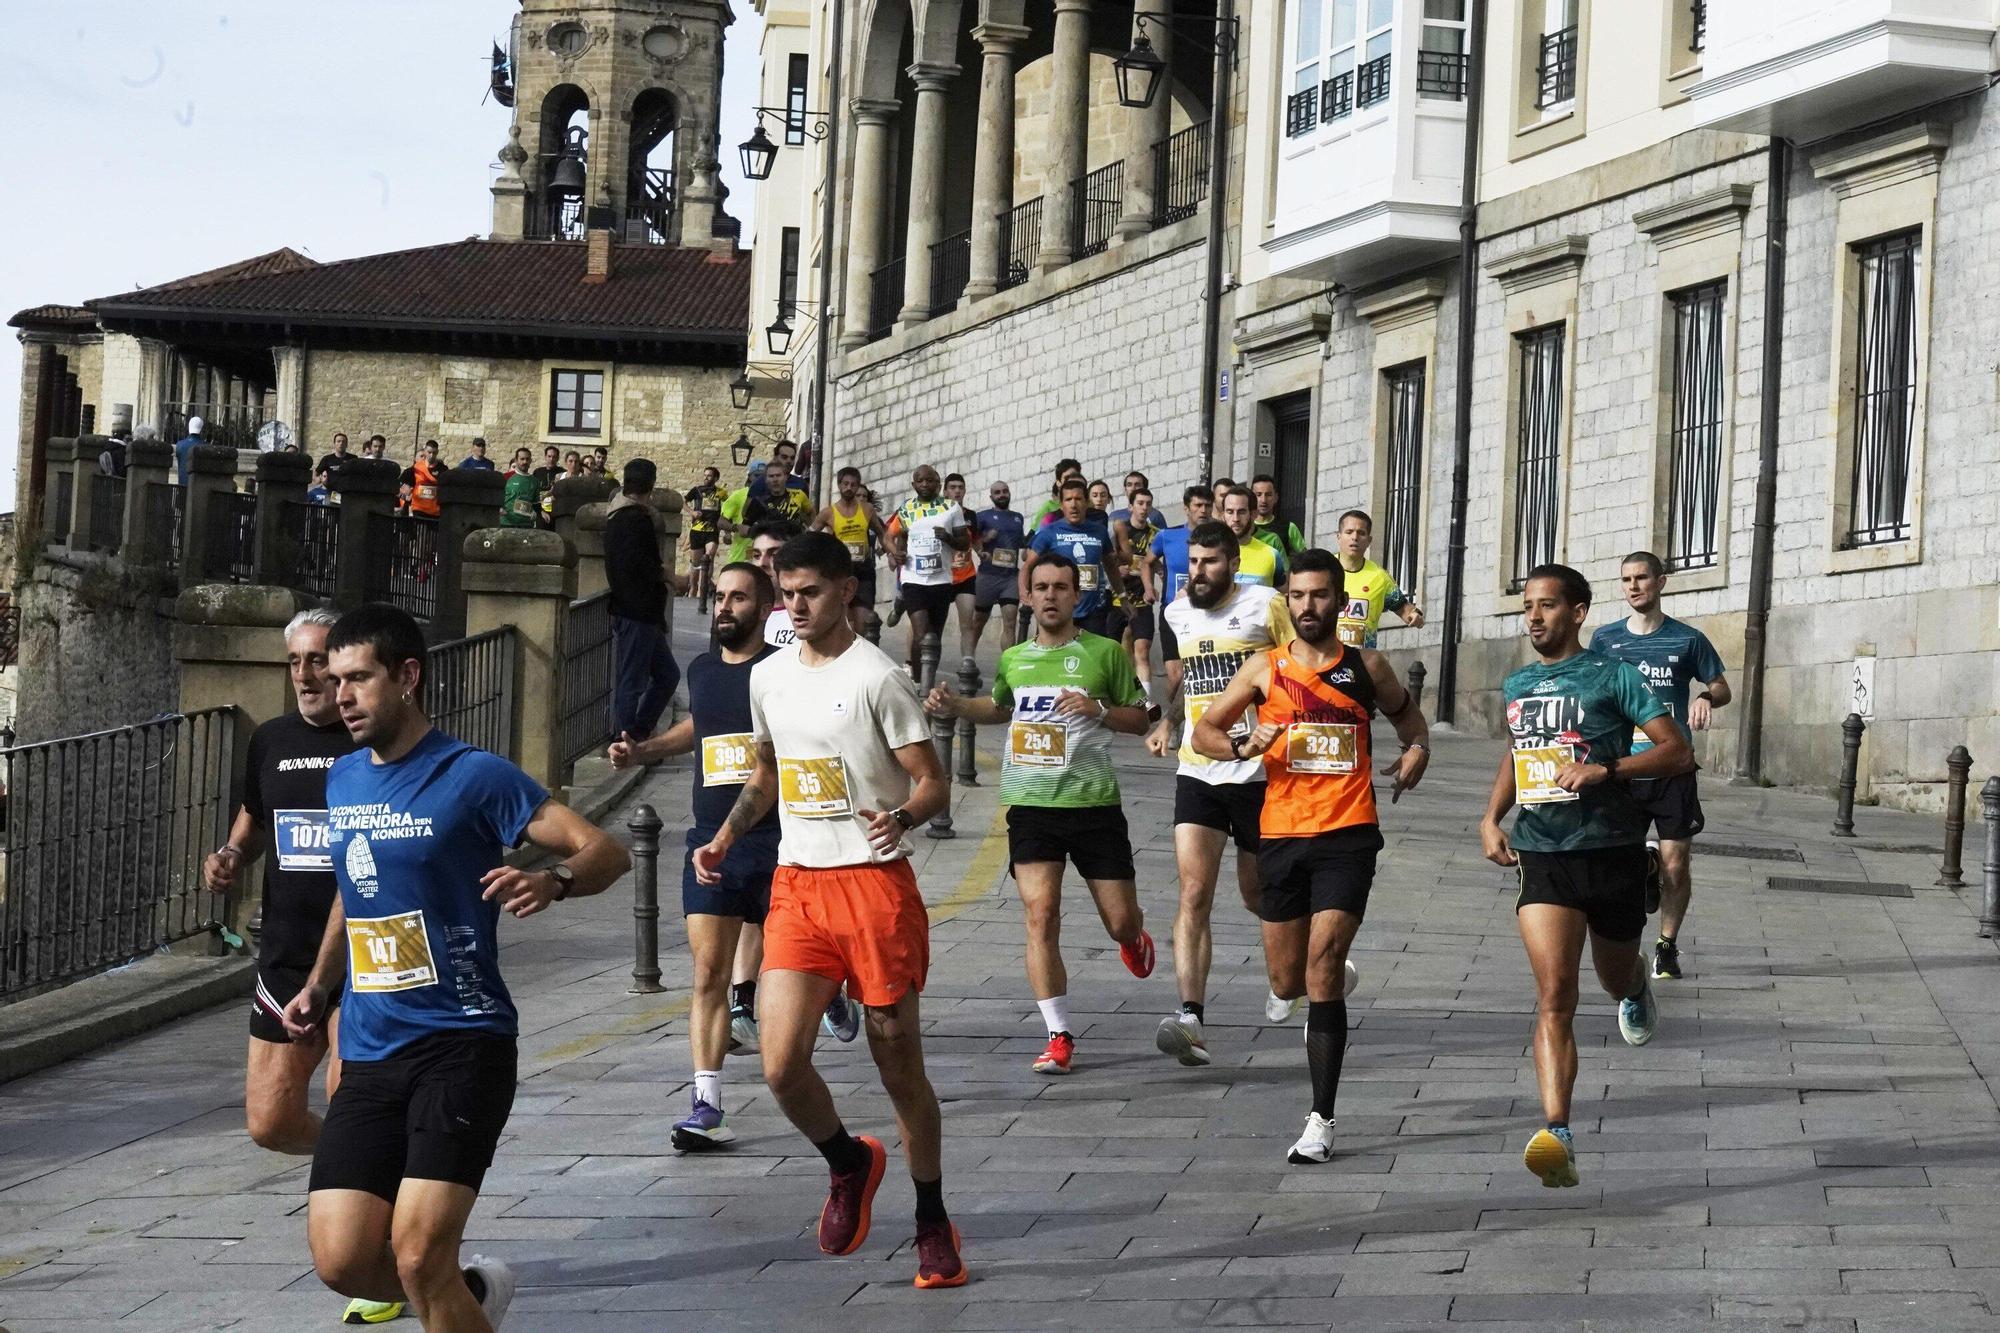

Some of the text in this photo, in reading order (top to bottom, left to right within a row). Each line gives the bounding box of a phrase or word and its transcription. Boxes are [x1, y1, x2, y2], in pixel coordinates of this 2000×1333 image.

[1261, 445, 1269, 454] 5
[919, 559, 937, 568] 1047
[1079, 570, 1092, 581] 30
[1199, 640, 1214, 653] 59
[1650, 679, 1674, 687] TRAIL
[1019, 695, 1056, 712] LE
[1024, 732, 1051, 750] 254
[1306, 735, 1340, 755] 328
[715, 746, 746, 766] 398
[277, 757, 335, 771] RUNNING
[1526, 761, 1556, 782] 290
[797, 772, 821, 795] 35
[337, 804, 391, 816] CONQUISTA
[334, 812, 414, 831] ALMENDRA
[414, 818, 433, 826] REN
[290, 825, 330, 849] 1078
[371, 827, 434, 841] KONKISTA
[403, 920, 417, 929] 10K
[366, 936, 398, 964] 147
